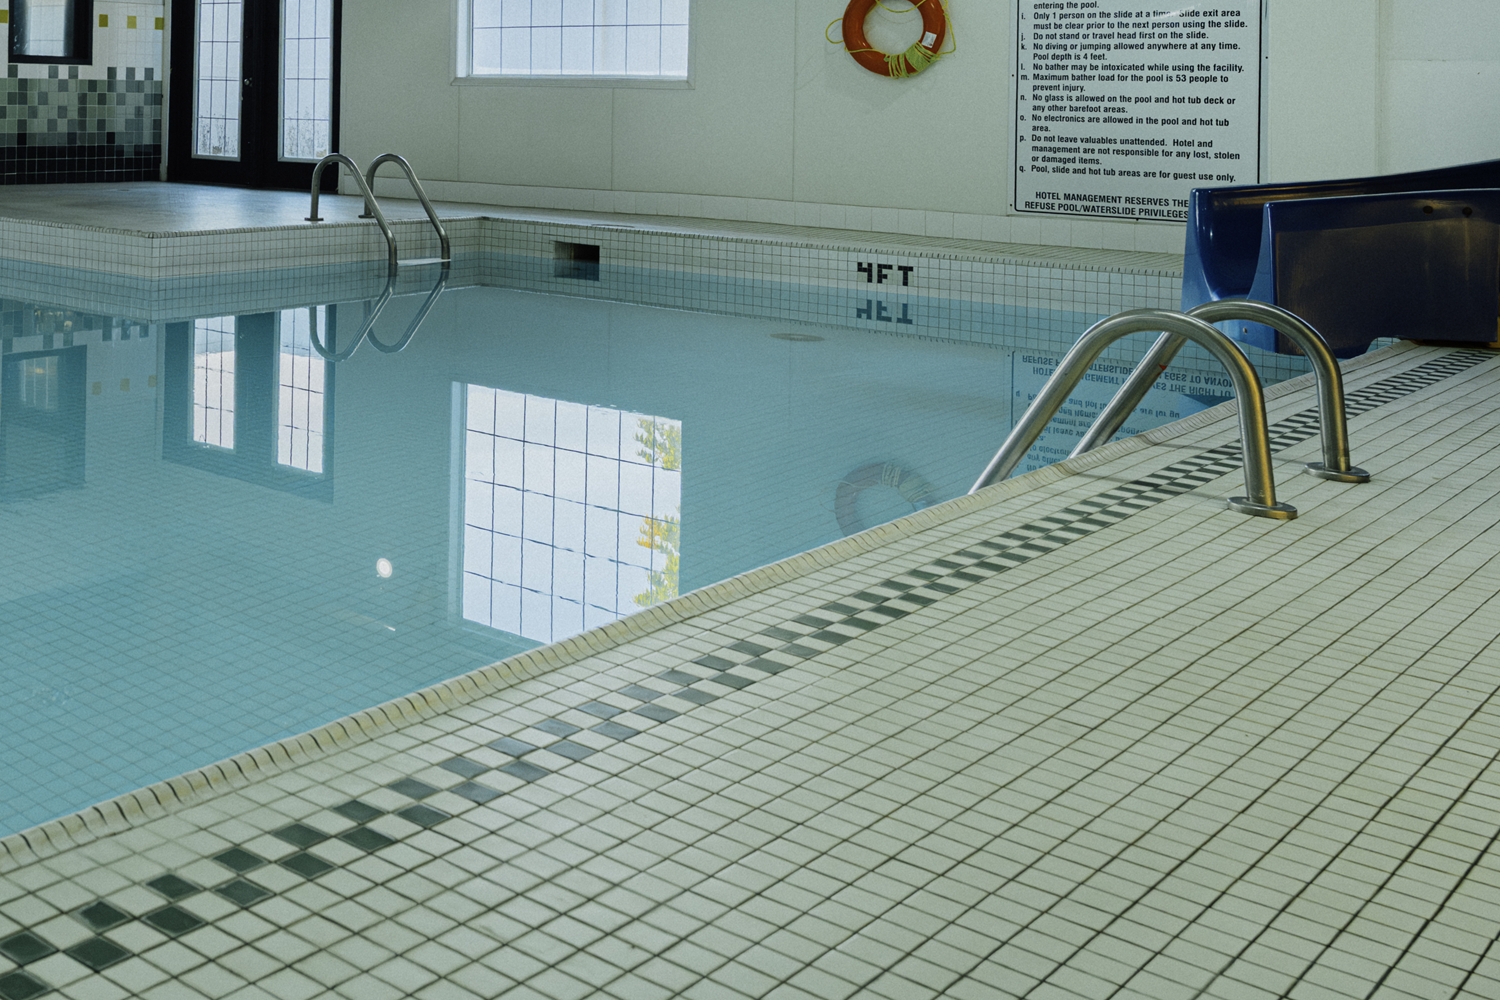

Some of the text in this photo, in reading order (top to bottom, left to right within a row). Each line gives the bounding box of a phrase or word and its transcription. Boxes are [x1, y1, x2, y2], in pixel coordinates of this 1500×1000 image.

[1020, 32, 1026, 41] j.
[1033, 32, 1044, 40] Do
[1044, 32, 1057, 40] not
[1058, 31, 1080, 40] stand
[1091, 31, 1115, 40] travel
[1116, 31, 1137, 40] head
[1138, 31, 1156, 39] first
[1169, 30, 1184, 39] the
[1185, 30, 1209, 39] slide.
[1032, 42, 1044, 50] No
[1044, 42, 1068, 52] diving
[1079, 41, 1111, 52] jumping
[1113, 41, 1145, 50] allowed
[1146, 41, 1187, 52] anywhere
[1189, 41, 1199, 50] at
[1200, 42, 1216, 51] any
[1218, 41, 1241, 50] time.
[1032, 52, 1108, 62] Pool depth is 4 feet.
[1032, 62, 1043, 71] No
[1044, 62, 1069, 71] bather
[1070, 64, 1088, 72] may
[1089, 62, 1099, 71] be
[1100, 62, 1145, 71] intoxicated
[1146, 62, 1170, 72] while
[1171, 63, 1195, 73] using
[1196, 63, 1211, 72] the
[1212, 63, 1245, 74] facility.
[1032, 72, 1070, 81] Maximum
[1070, 73, 1096, 81] bather
[1097, 73, 1115, 82] load
[1116, 73, 1129, 82] for
[1130, 73, 1144, 82] the
[1145, 73, 1164, 84] pool
[1165, 73, 1174, 82] is
[1175, 73, 1187, 83] 53
[1188, 74, 1218, 84] people
[1219, 74, 1229, 83] to
[1032, 83, 1086, 93] prevent injury.
[1031, 113, 1042, 122] No
[1043, 113, 1085, 123] electronics
[1102, 115, 1134, 124] allowed
[1135, 116, 1144, 124] in
[1145, 116, 1159, 125] the
[1160, 117, 1179, 126] pool
[1181, 117, 1197, 126] and
[1199, 117, 1213, 126] hot
[1215, 118, 1230, 127] tub
[1018, 164, 1236, 183] q. Pool, slide and hot tub areas are for guest use only.
[1035, 191, 1187, 208] HOTEL MANAGEMENT RESERVES THE
[1024, 200, 1187, 219] REFUSE POOL/WATERSLIDE PRIVILEGES
